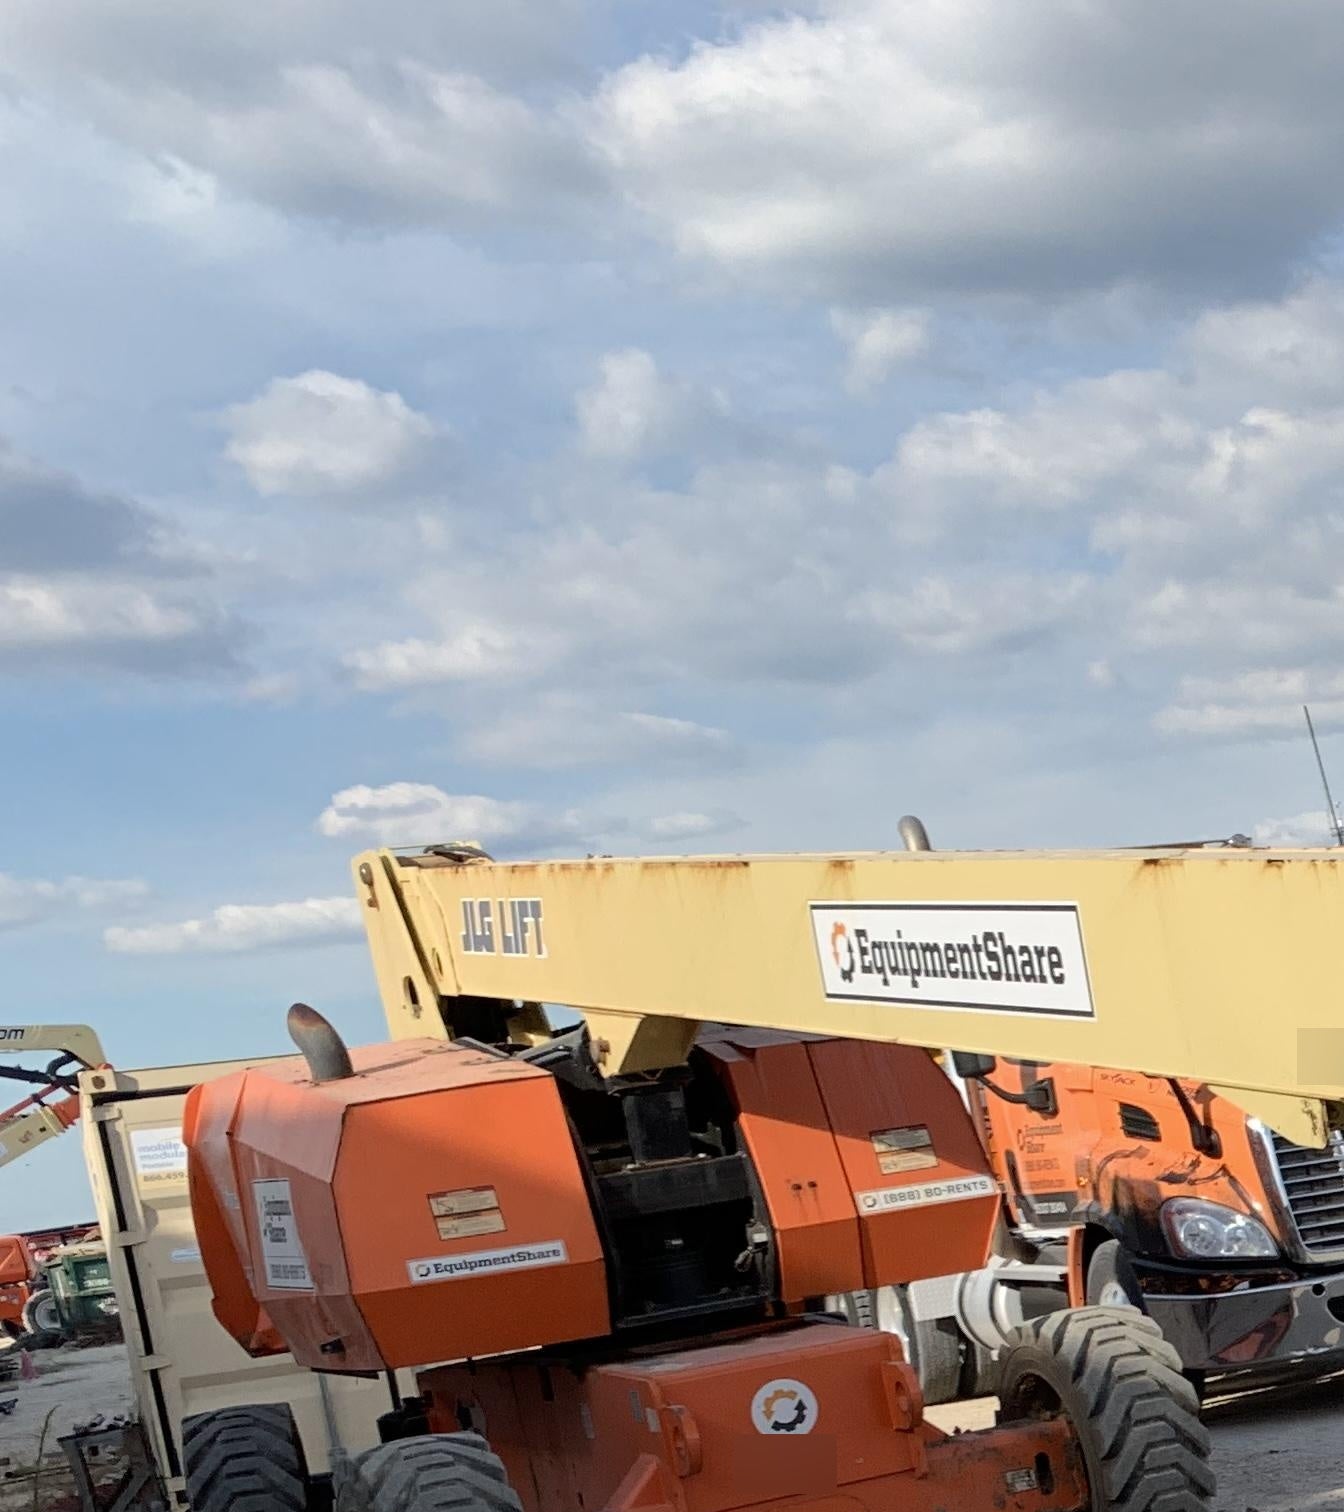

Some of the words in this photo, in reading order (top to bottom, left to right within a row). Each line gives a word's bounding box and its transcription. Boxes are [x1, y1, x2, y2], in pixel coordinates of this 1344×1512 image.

[461, 898, 496, 956] JLG
[497, 898, 546, 958] LIFT
[854, 929, 1066, 988] EquipmentShare
[139, 1151, 186, 1160] modula
[433, 1248, 561, 1275] EquipmentShare
